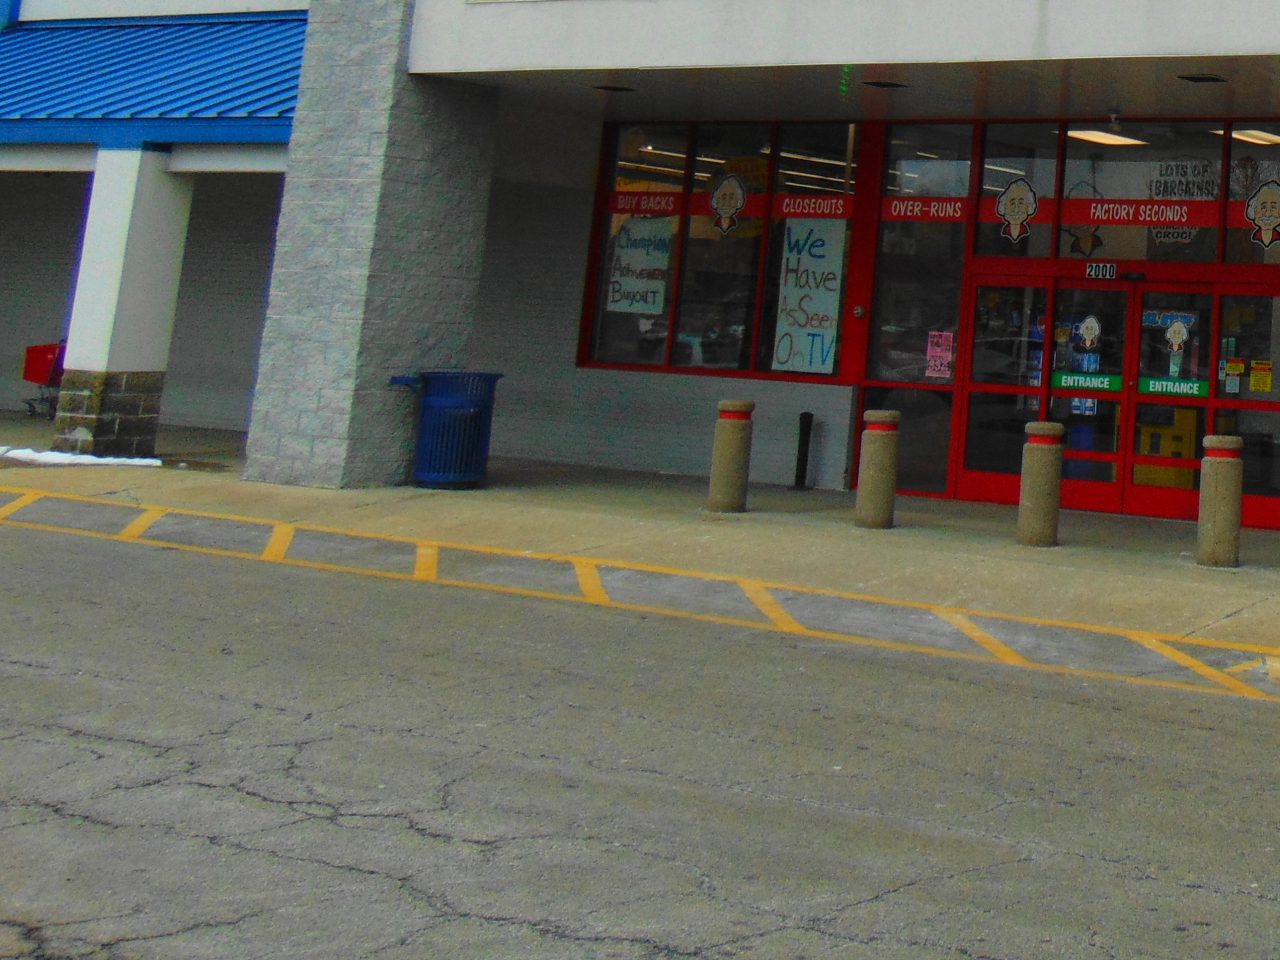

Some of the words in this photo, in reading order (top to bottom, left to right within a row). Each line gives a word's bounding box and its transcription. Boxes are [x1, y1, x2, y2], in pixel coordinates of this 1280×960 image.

[1159, 163, 1188, 178] LOTS
[1191, 163, 1210, 178] OF
[617, 195, 639, 210] BUY
[640, 196, 675, 211] BACKS
[783, 198, 844, 214] CLOSEOUTS
[891, 201, 962, 218] OVER-RUNS
[1090, 203, 1136, 221] FACTORY
[1138, 205, 1188, 222] SECONDS
[786, 226, 826, 259] We
[783, 257, 837, 292] Have
[1087, 264, 1116, 278] 2000
[775, 333, 804, 368] On
[807, 332, 836, 367] TV
[1061, 375, 1110, 389] ENTRANCE
[1149, 380, 1200, 395] ENTRANCE
